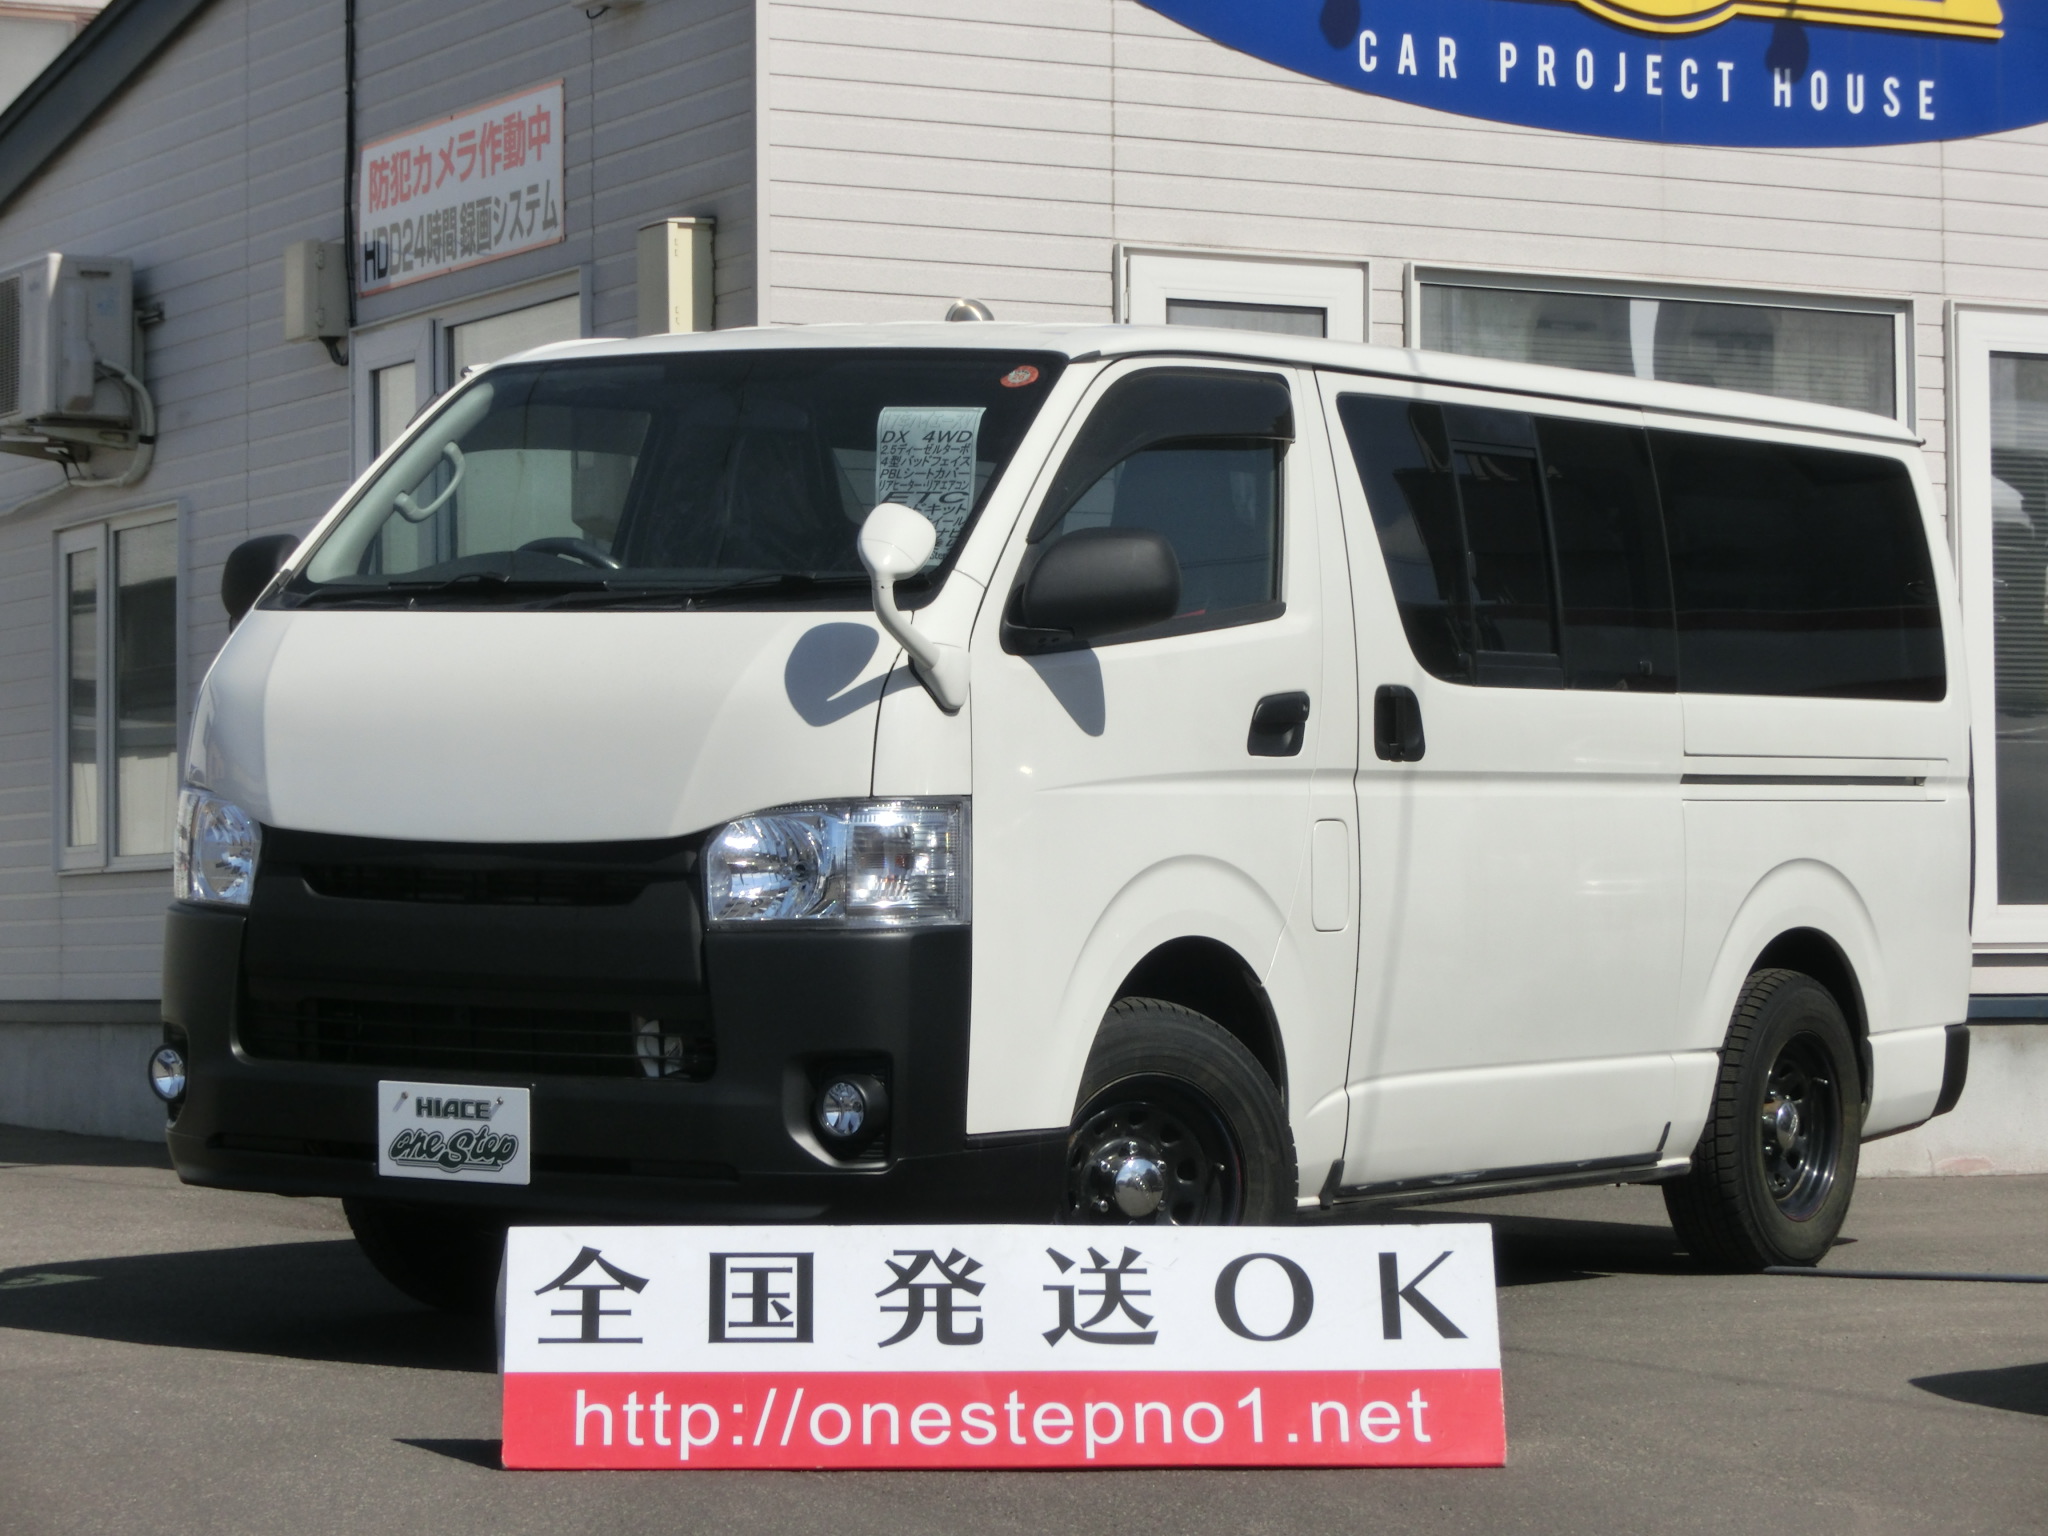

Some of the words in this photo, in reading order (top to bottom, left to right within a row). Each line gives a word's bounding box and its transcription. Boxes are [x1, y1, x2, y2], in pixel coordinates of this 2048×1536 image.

[1358, 29, 1458, 79] CAR
[1499, 41, 1734, 103] PROJECT
[1773, 67, 1936, 121] HOUSE
[368, 104, 551, 214] 防犯カメラ作動中
[363, 179, 559, 283] HDD24時間録画システム
[880, 430, 910, 443] DX
[922, 430, 973, 443] 4WD
[881, 491, 970, 504] ETC
[415, 1096, 492, 1121] HIACE
[533, 1245, 1470, 1348] 全国発送OK
[574, 1387, 1432, 1461] http://onestepno1.net
